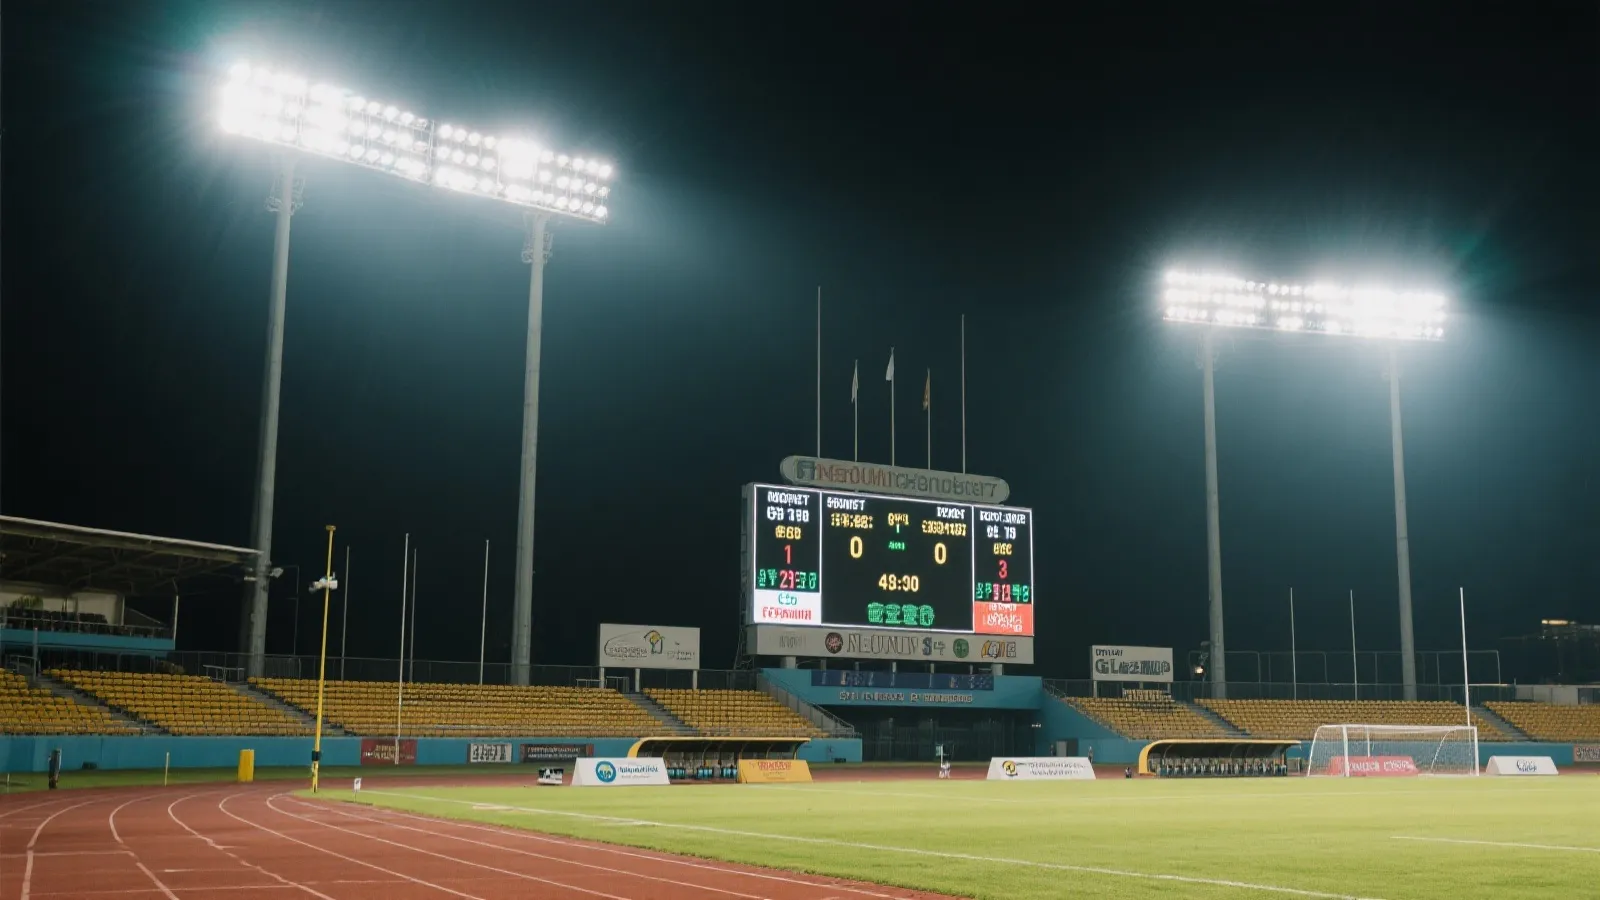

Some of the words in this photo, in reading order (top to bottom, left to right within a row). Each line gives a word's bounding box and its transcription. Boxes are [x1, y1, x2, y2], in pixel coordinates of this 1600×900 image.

[784, 544, 791, 564] 1
[850, 536, 863, 558] 0
[934, 542, 947, 565] 0
[998, 560, 1008, 579] 3
